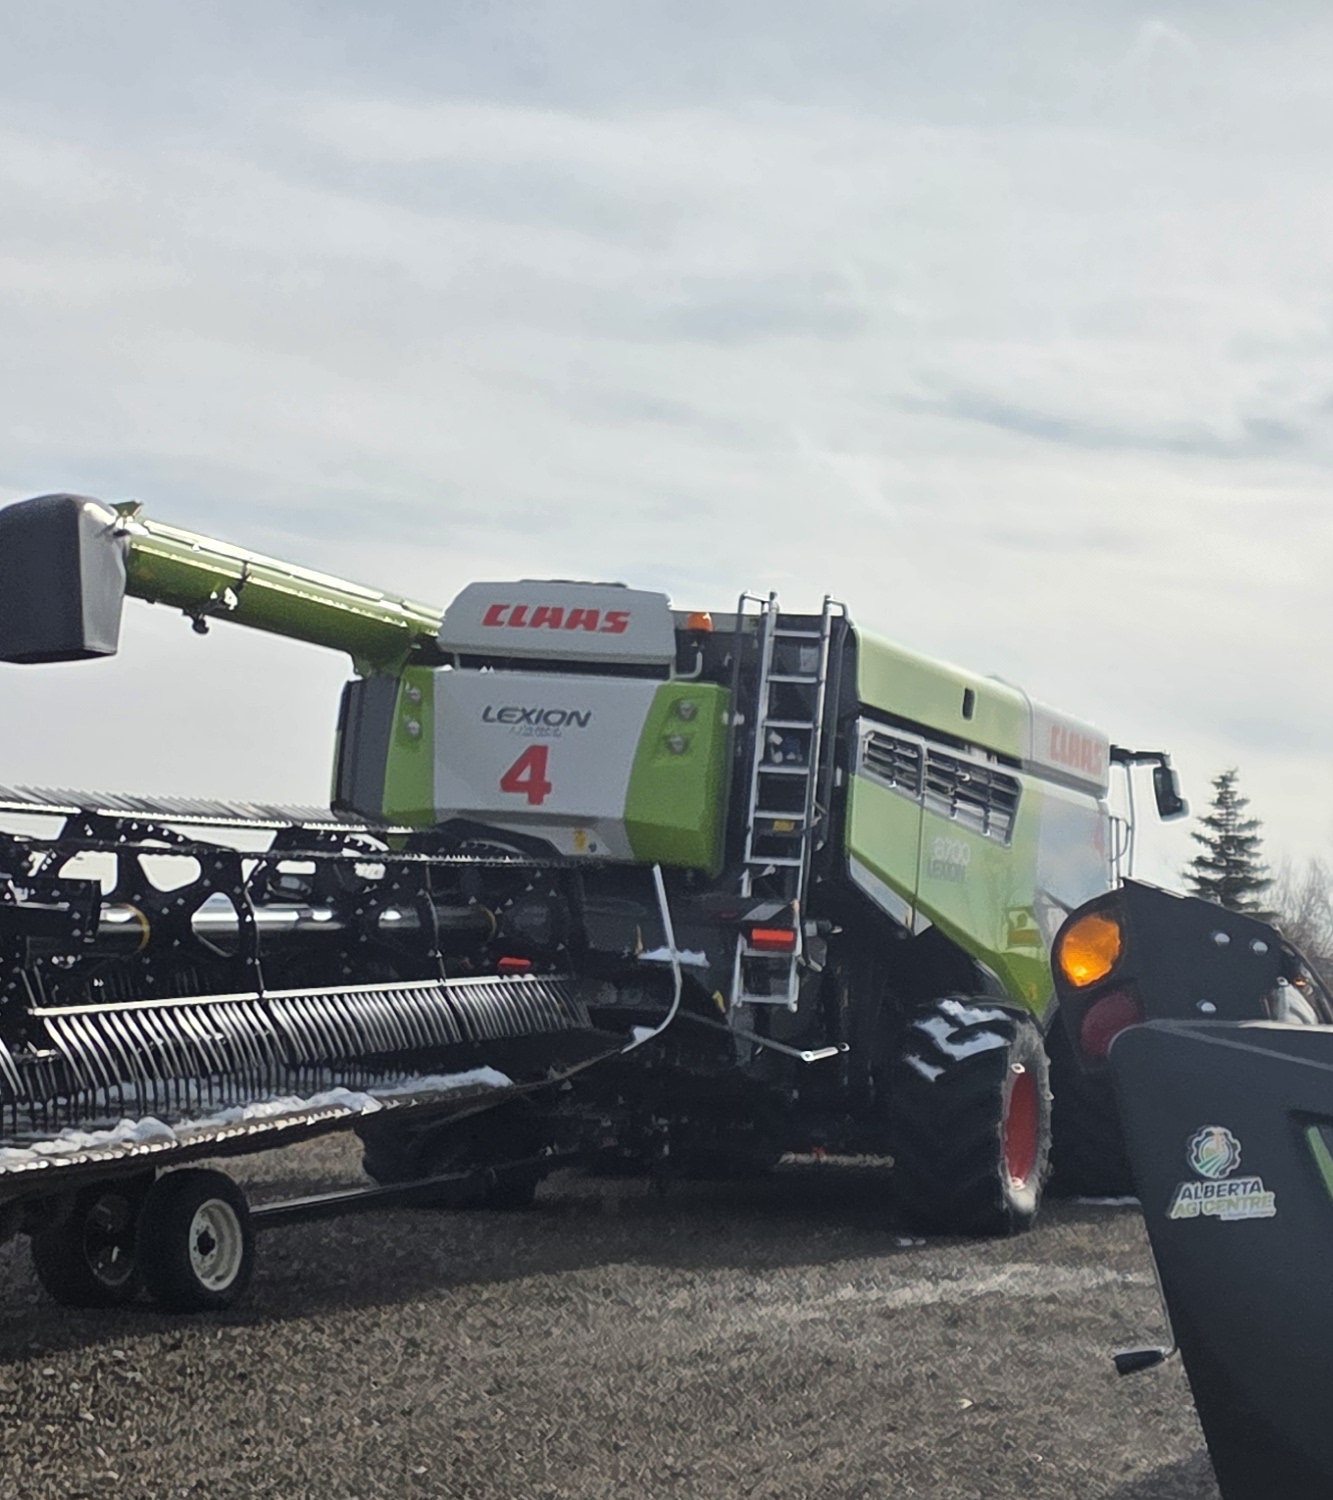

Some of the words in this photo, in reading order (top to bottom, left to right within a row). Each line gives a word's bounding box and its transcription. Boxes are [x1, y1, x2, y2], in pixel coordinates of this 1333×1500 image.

[482, 604, 631, 634] CLAAS
[482, 705, 592, 729] LEXION
[501, 743, 553, 806] 4
[1180, 1180, 1262, 1201] ALBERTA
[1173, 1200, 1198, 1217] AG
[1203, 1194, 1273, 1214] CENTRE
